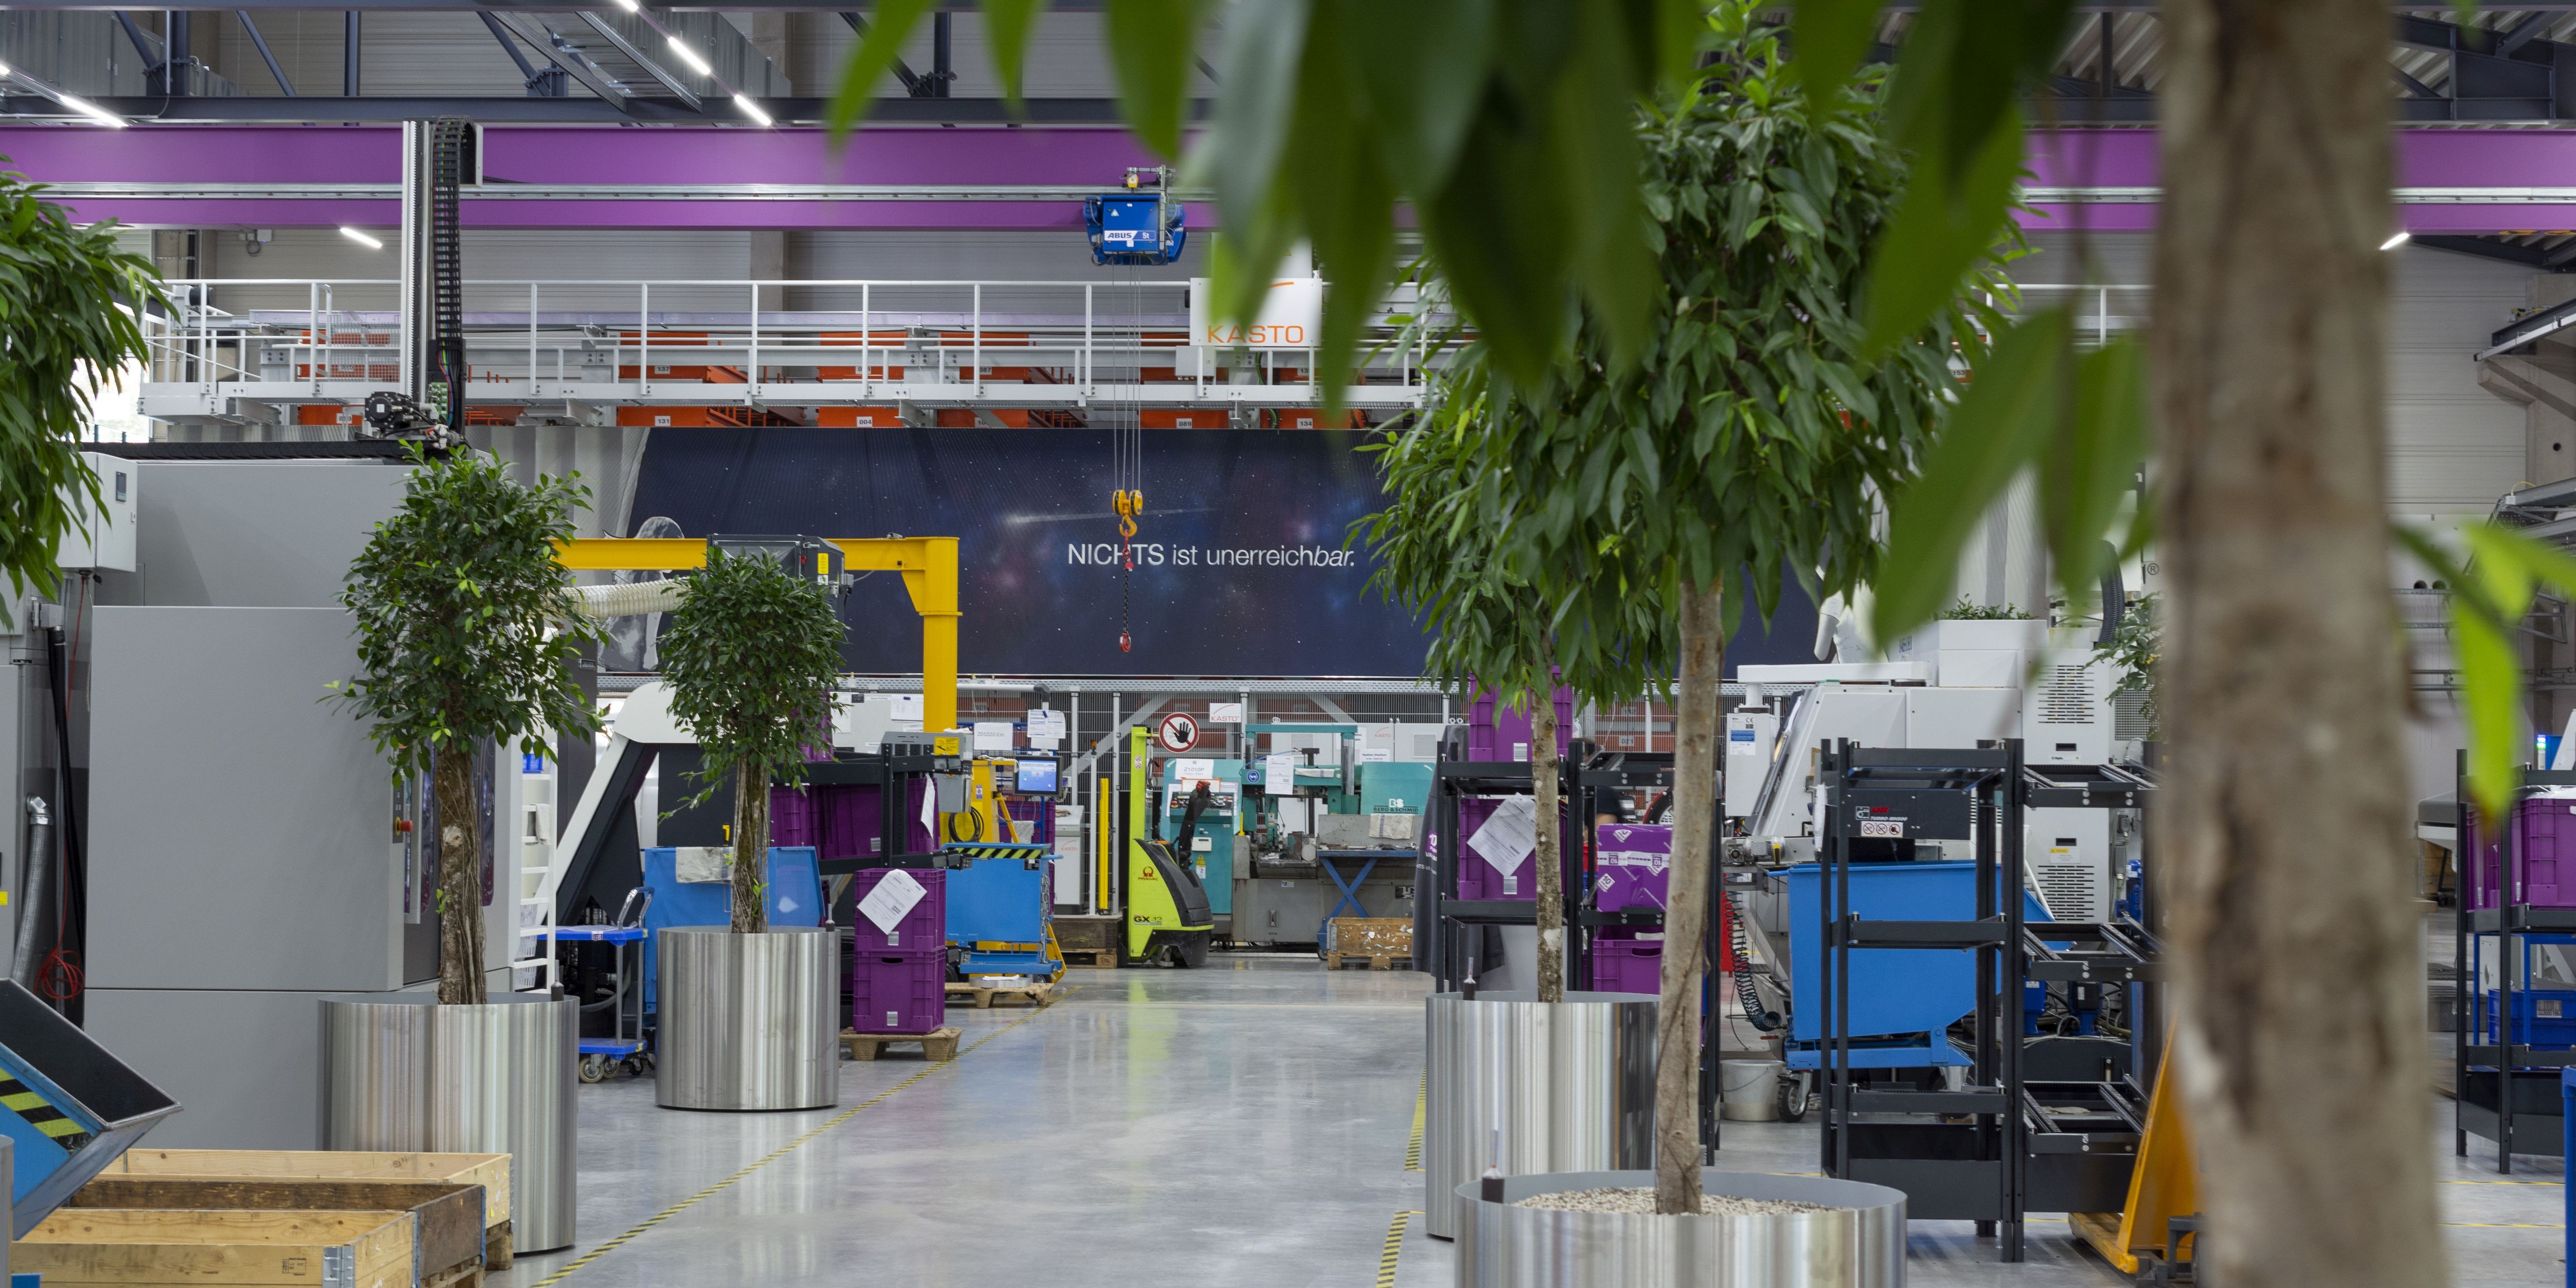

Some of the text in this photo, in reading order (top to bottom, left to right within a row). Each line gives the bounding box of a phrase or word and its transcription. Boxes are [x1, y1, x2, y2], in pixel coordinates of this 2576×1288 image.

[1207, 325, 1304, 344] KASTO
[1068, 543, 1355, 566] NICHTS ist unerreichbar.
